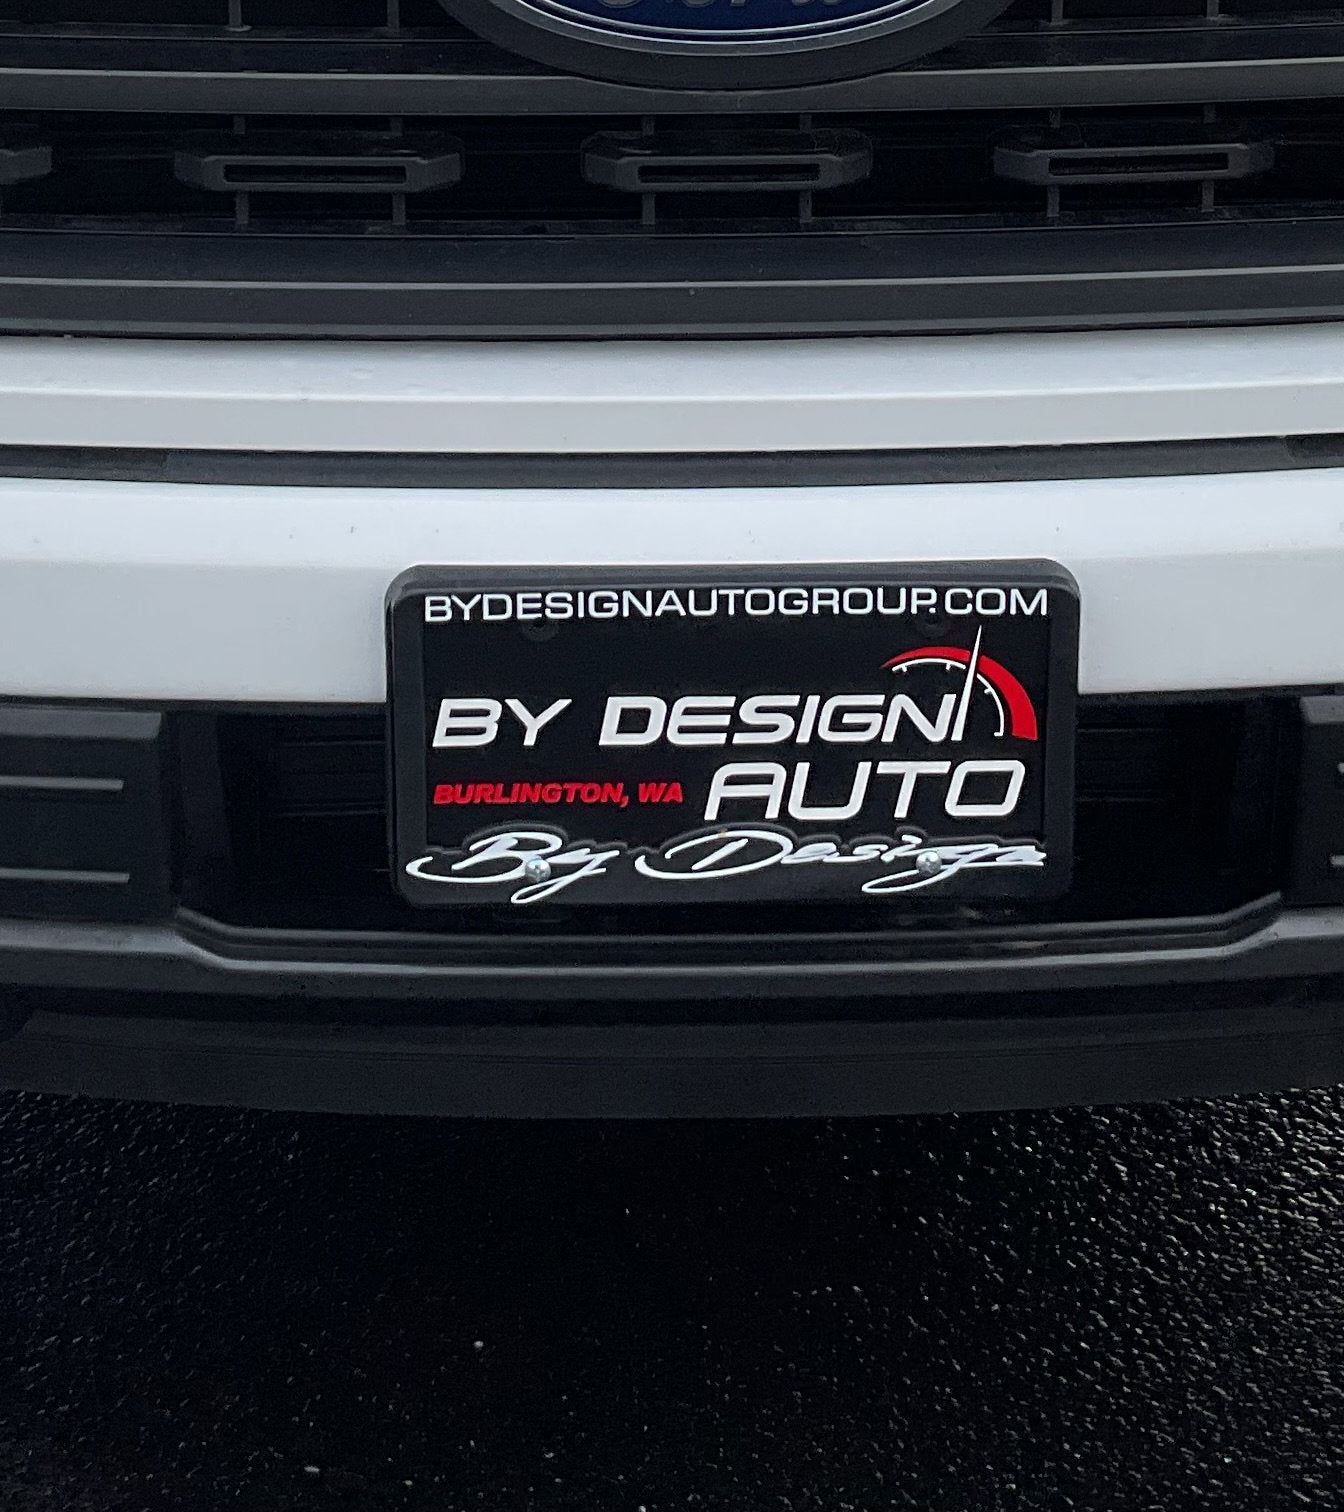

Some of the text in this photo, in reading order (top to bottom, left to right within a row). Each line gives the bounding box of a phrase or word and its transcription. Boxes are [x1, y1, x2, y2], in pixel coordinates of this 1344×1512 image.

[424, 587, 1048, 623] BYDESIGNAUTOGROUP.COM
[432, 694, 957, 747] BY DESIGN
[433, 782, 684, 808] BURLINGTON, WA
[703, 759, 1025, 821] AUTO
[405, 829, 1047, 904] By Design
